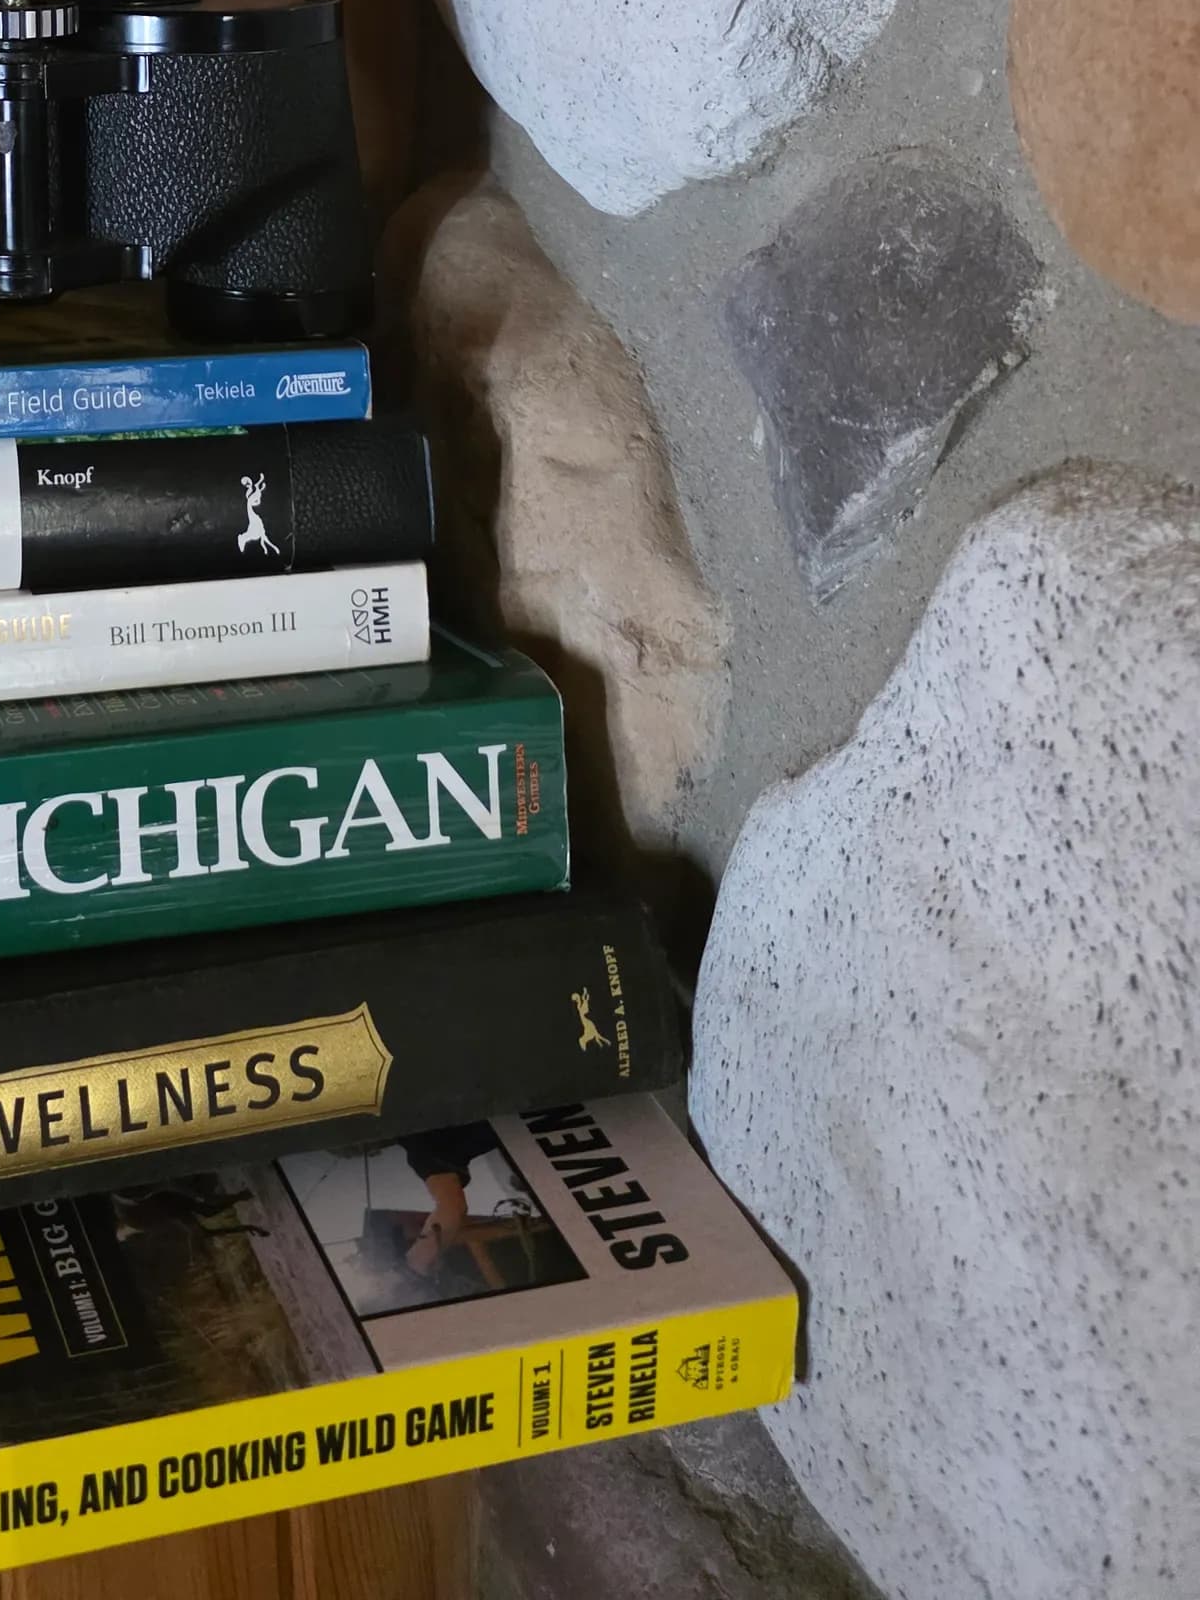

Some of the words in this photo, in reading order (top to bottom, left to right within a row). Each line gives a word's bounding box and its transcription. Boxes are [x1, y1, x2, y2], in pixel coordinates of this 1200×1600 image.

[8, 390, 62, 415] Field
[73, 385, 142, 410] Guide
[195, 381, 255, 401] Tekiela
[37, 466, 94, 490] Knopf
[110, 621, 146, 647] Bill
[152, 615, 264, 645] Thompson
[271, 612, 297, 632] III
[372, 588, 392, 644] HMH
[602, 945, 622, 997] KNOPF
[614, 1000, 625, 1015] A.
[615, 1020, 630, 1077] ALFRED
[519, 1103, 690, 1270] STEVEN
[41, 1224, 83, 1279] BIG
[72, 1290, 107, 1344] VOLUME
[532, 1360, 550, 1377] 1
[586, 1341, 616, 1430] STEVEN
[628, 1329, 659, 1424] RINELLA
[532, 1379, 550, 1439] VOLUME
[78, 1461, 148, 1517] AND
[158, 1431, 306, 1500] COOKING
[316, 1411, 397, 1466] WILD
[405, 1392, 495, 1448] GAME
